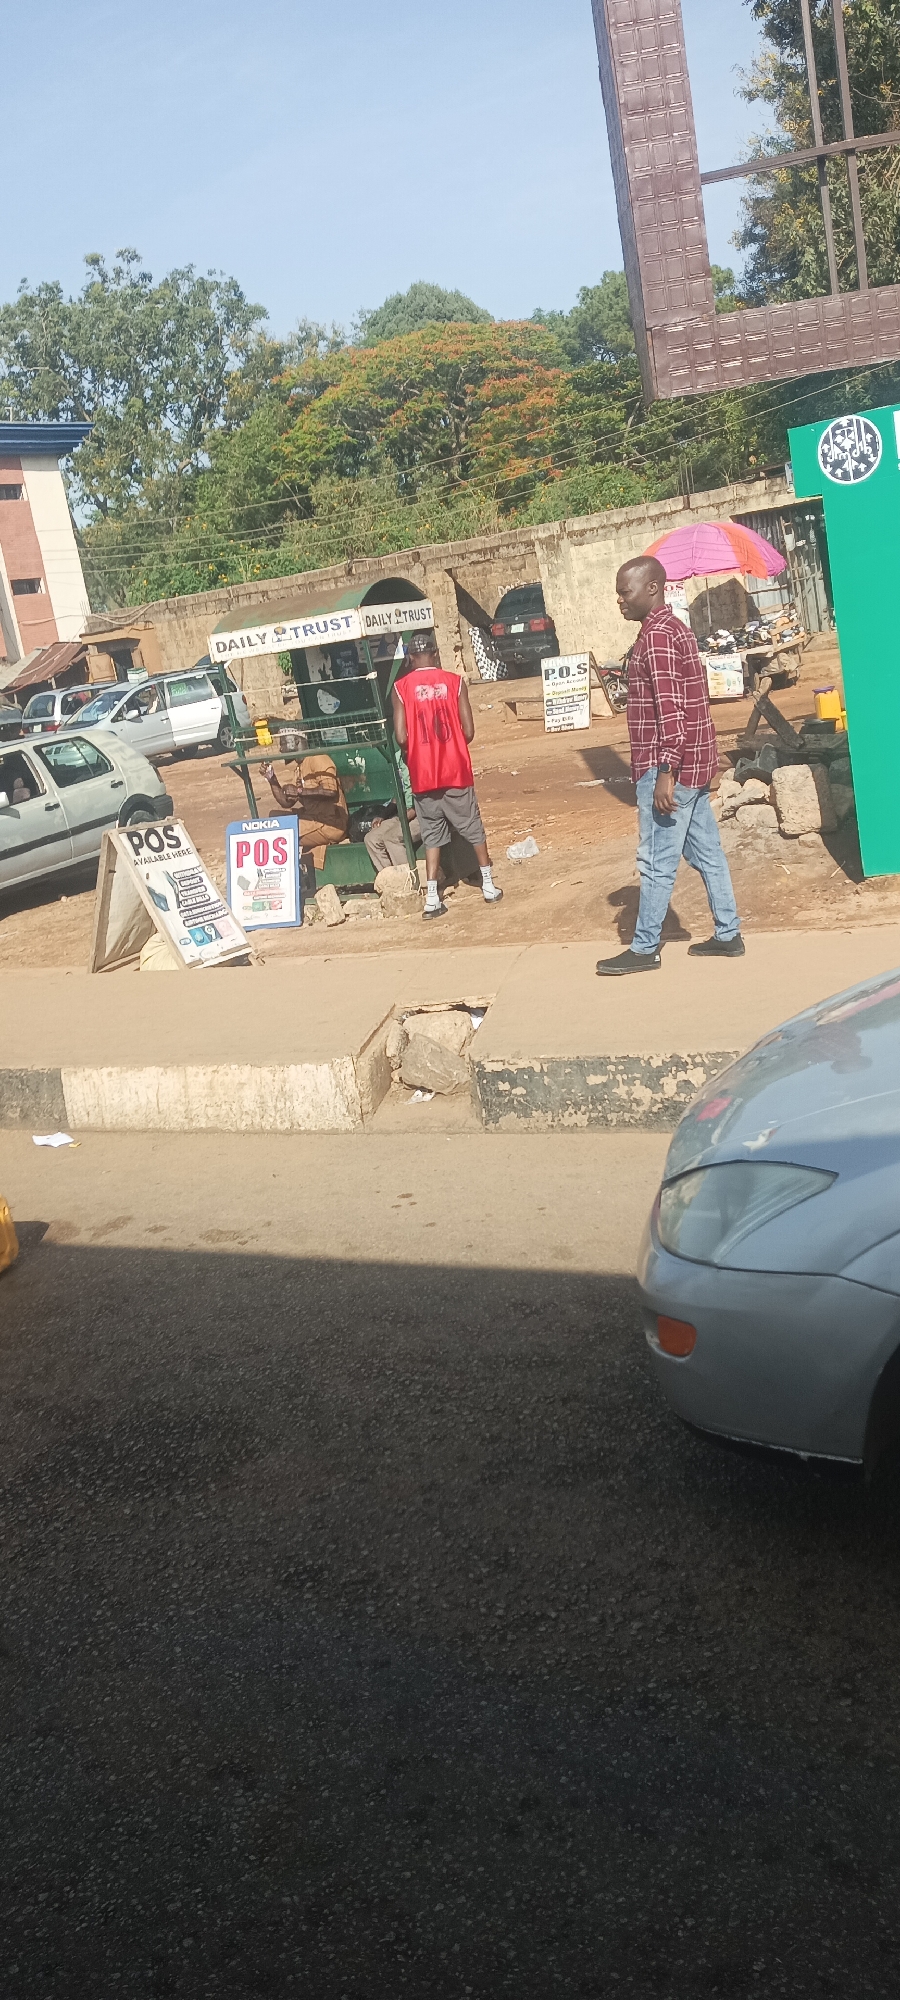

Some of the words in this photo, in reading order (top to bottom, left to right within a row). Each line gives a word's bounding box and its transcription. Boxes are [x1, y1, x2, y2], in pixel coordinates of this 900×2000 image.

[366, 613, 392, 627] DAILY
[402, 607, 431, 623] TRUST
[215, 632, 267, 653] DAILY
[290, 614, 352, 639] TRUST
[545, 662, 588, 681] P.O.S
[242, 820, 280, 832] NOKIA
[126, 824, 182, 857] POS
[133, 852, 171, 866] AVAILABLE
[236, 837, 287, 869] POS
